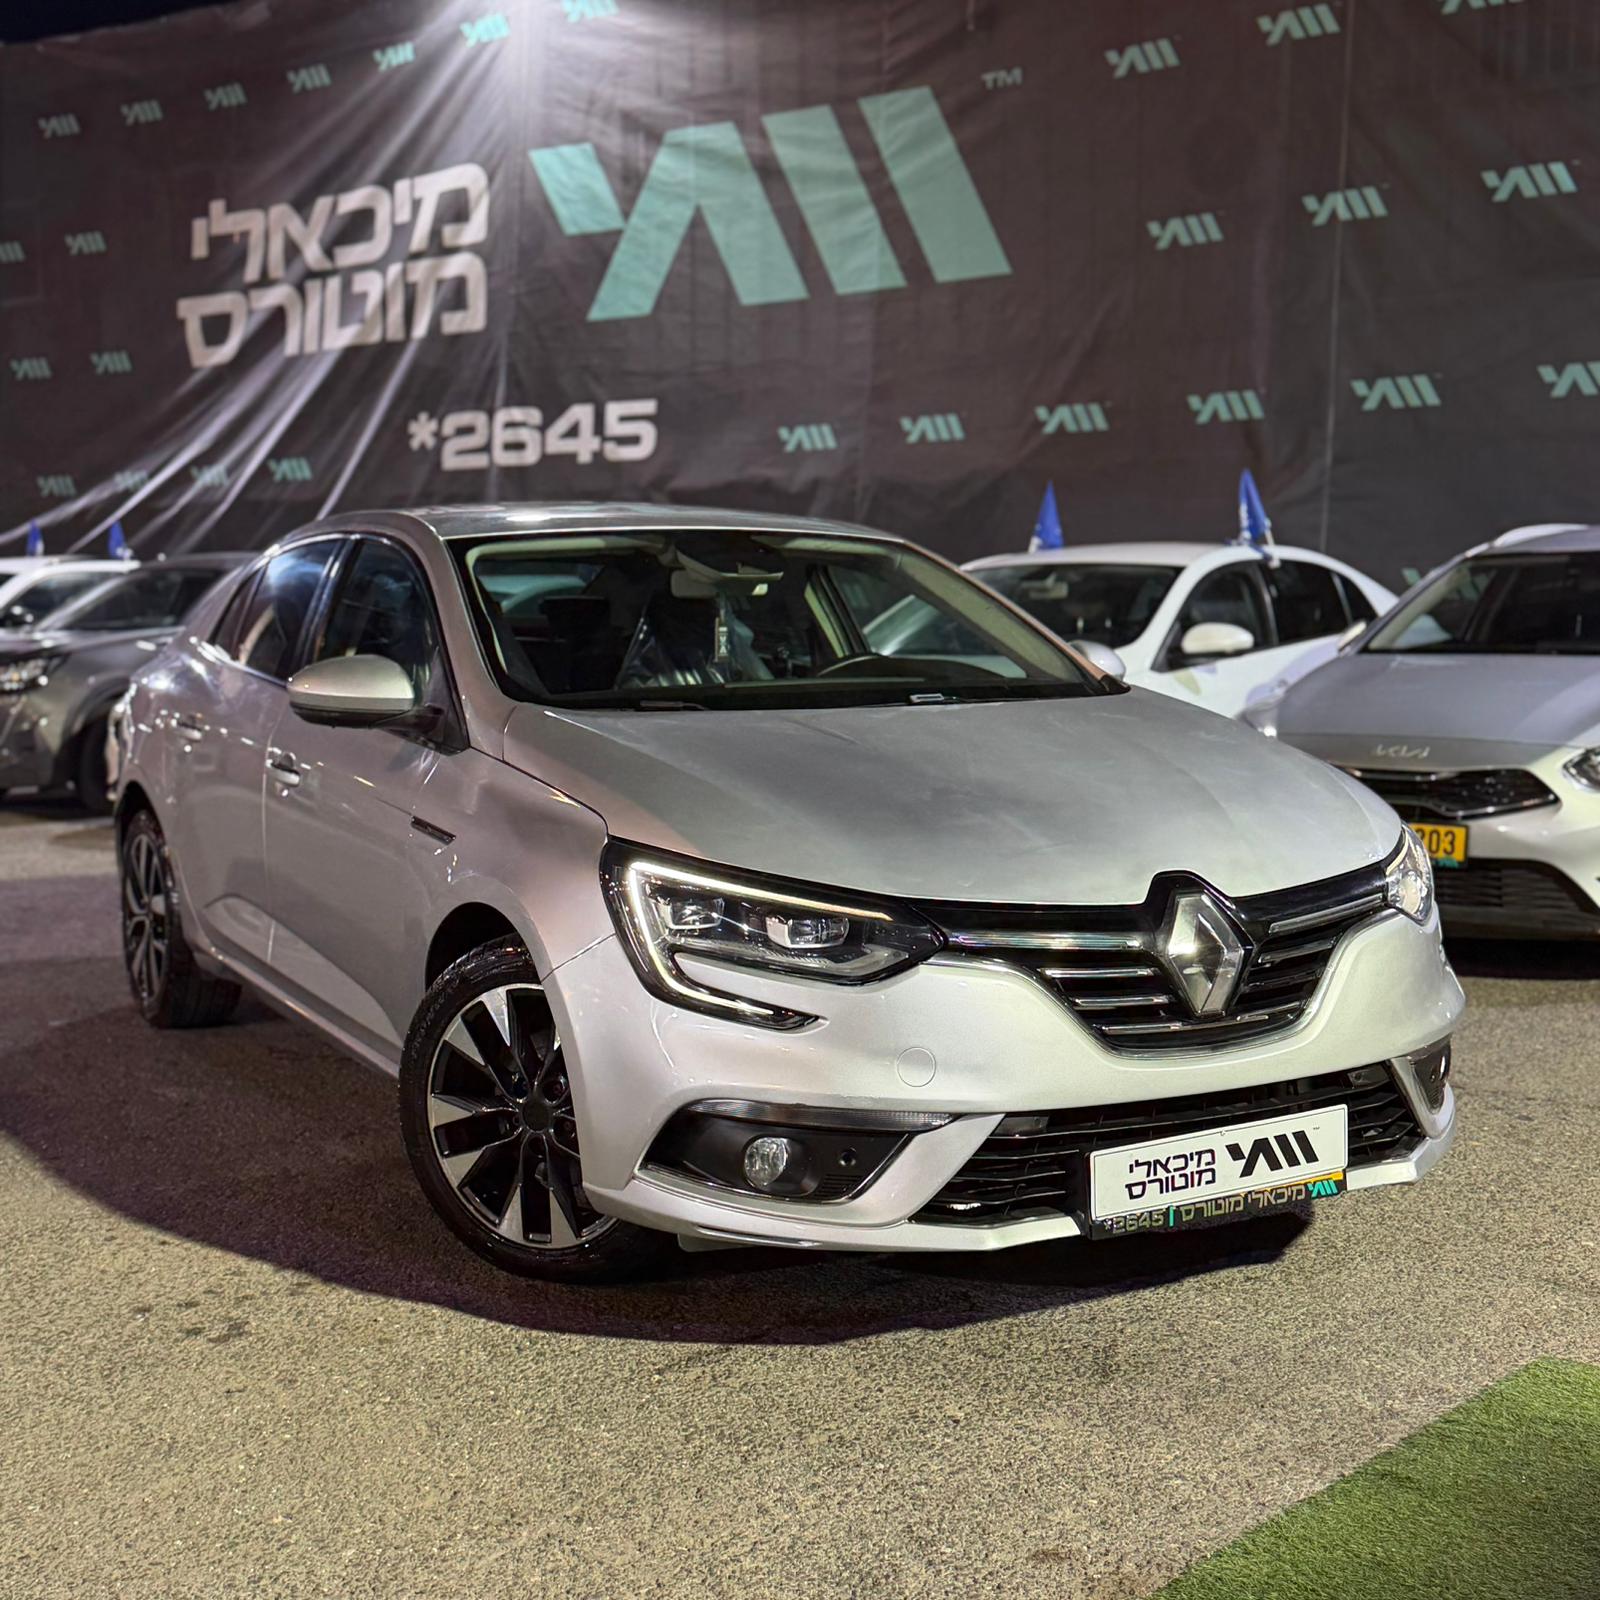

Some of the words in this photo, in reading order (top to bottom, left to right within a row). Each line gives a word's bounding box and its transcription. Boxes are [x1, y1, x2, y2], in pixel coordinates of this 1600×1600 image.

[191, 163, 489, 283] מיכאלי
[177, 252, 487, 368] מוטורס
[1129, 1149, 1216, 1178] מיכאלי
[1125, 1167, 1216, 1200] מוטורס
[1247, 1184, 1305, 1208] מיכאלי
[1180, 1197, 1243, 1221] מוטורס
